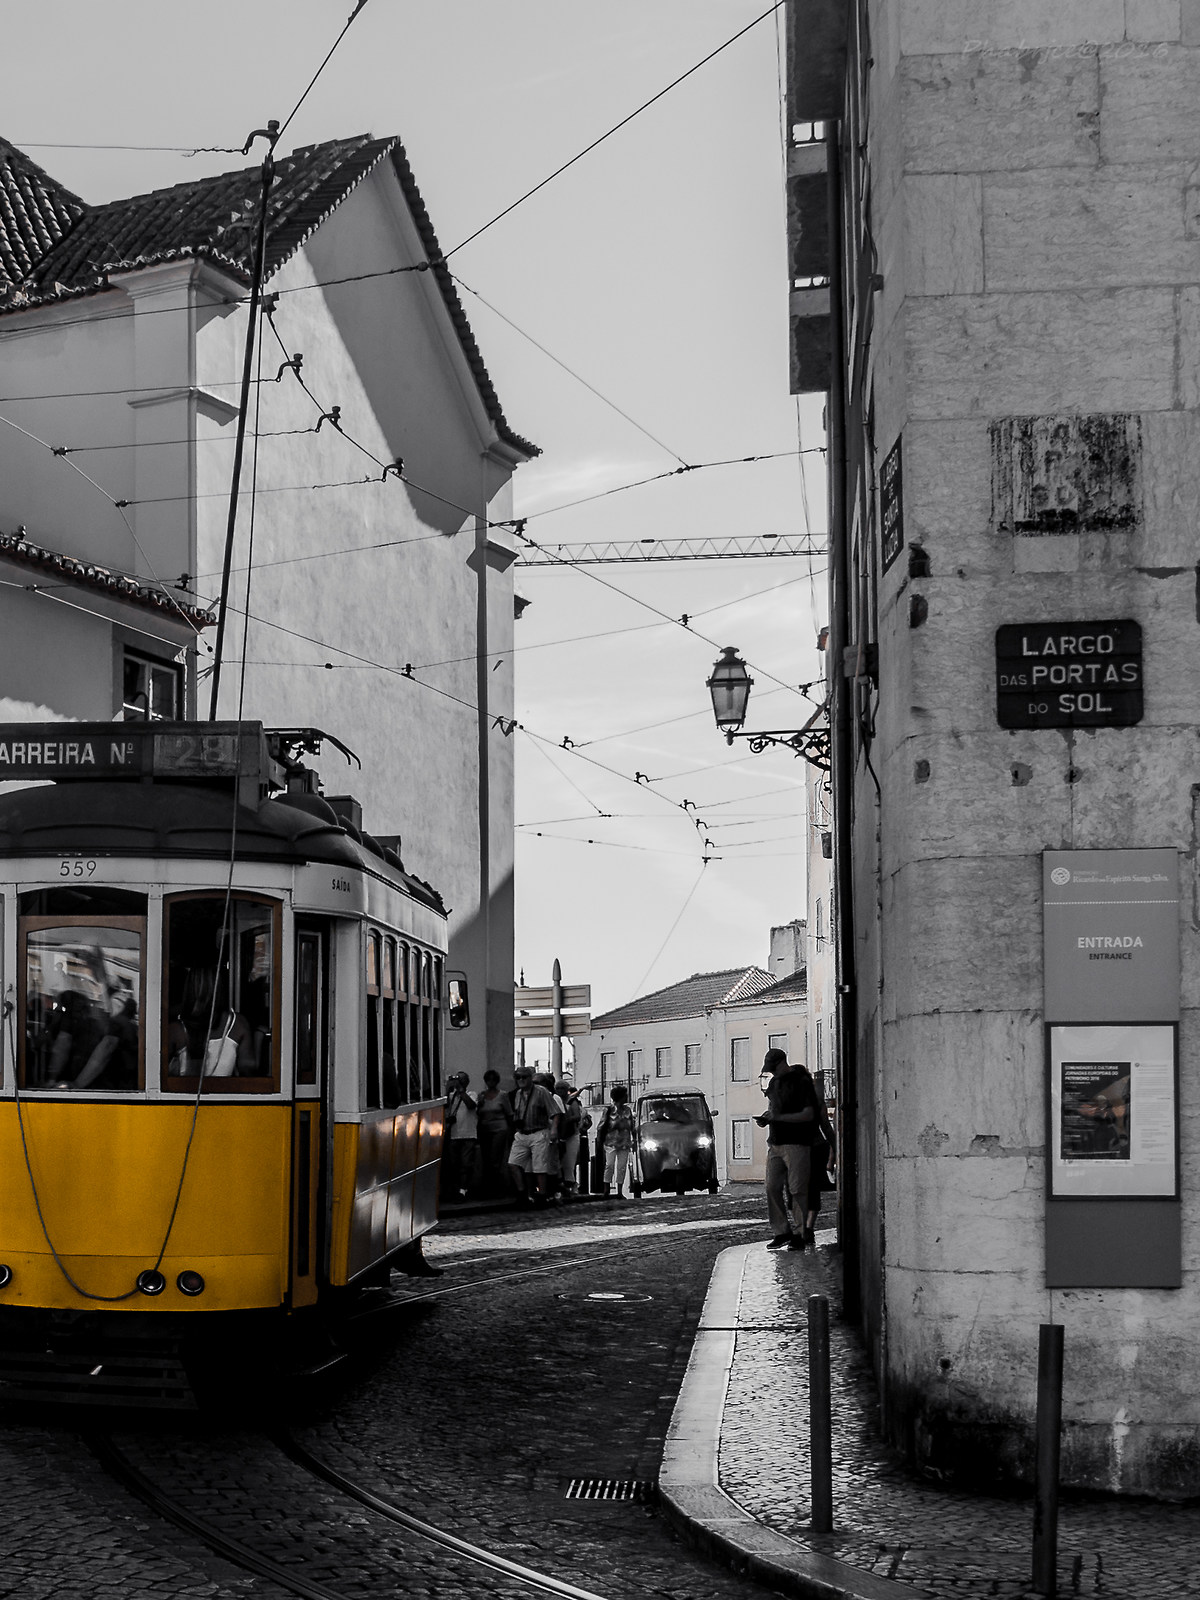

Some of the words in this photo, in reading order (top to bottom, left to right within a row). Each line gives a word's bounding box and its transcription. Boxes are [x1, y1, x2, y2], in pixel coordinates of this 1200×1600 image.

[1022, 634, 1114, 657] LARGO
[999, 674, 1028, 687] DAS
[1032, 662, 1139, 686] PORTAS
[1028, 702, 1049, 714] DO
[1058, 692, 1113, 713] SOL
[59, 860, 97, 877] 559
[332, 876, 351, 893] SAÍDA
[1077, 936, 1144, 949] ENTRADA
[1089, 952, 1133, 961] ENTRANCE
